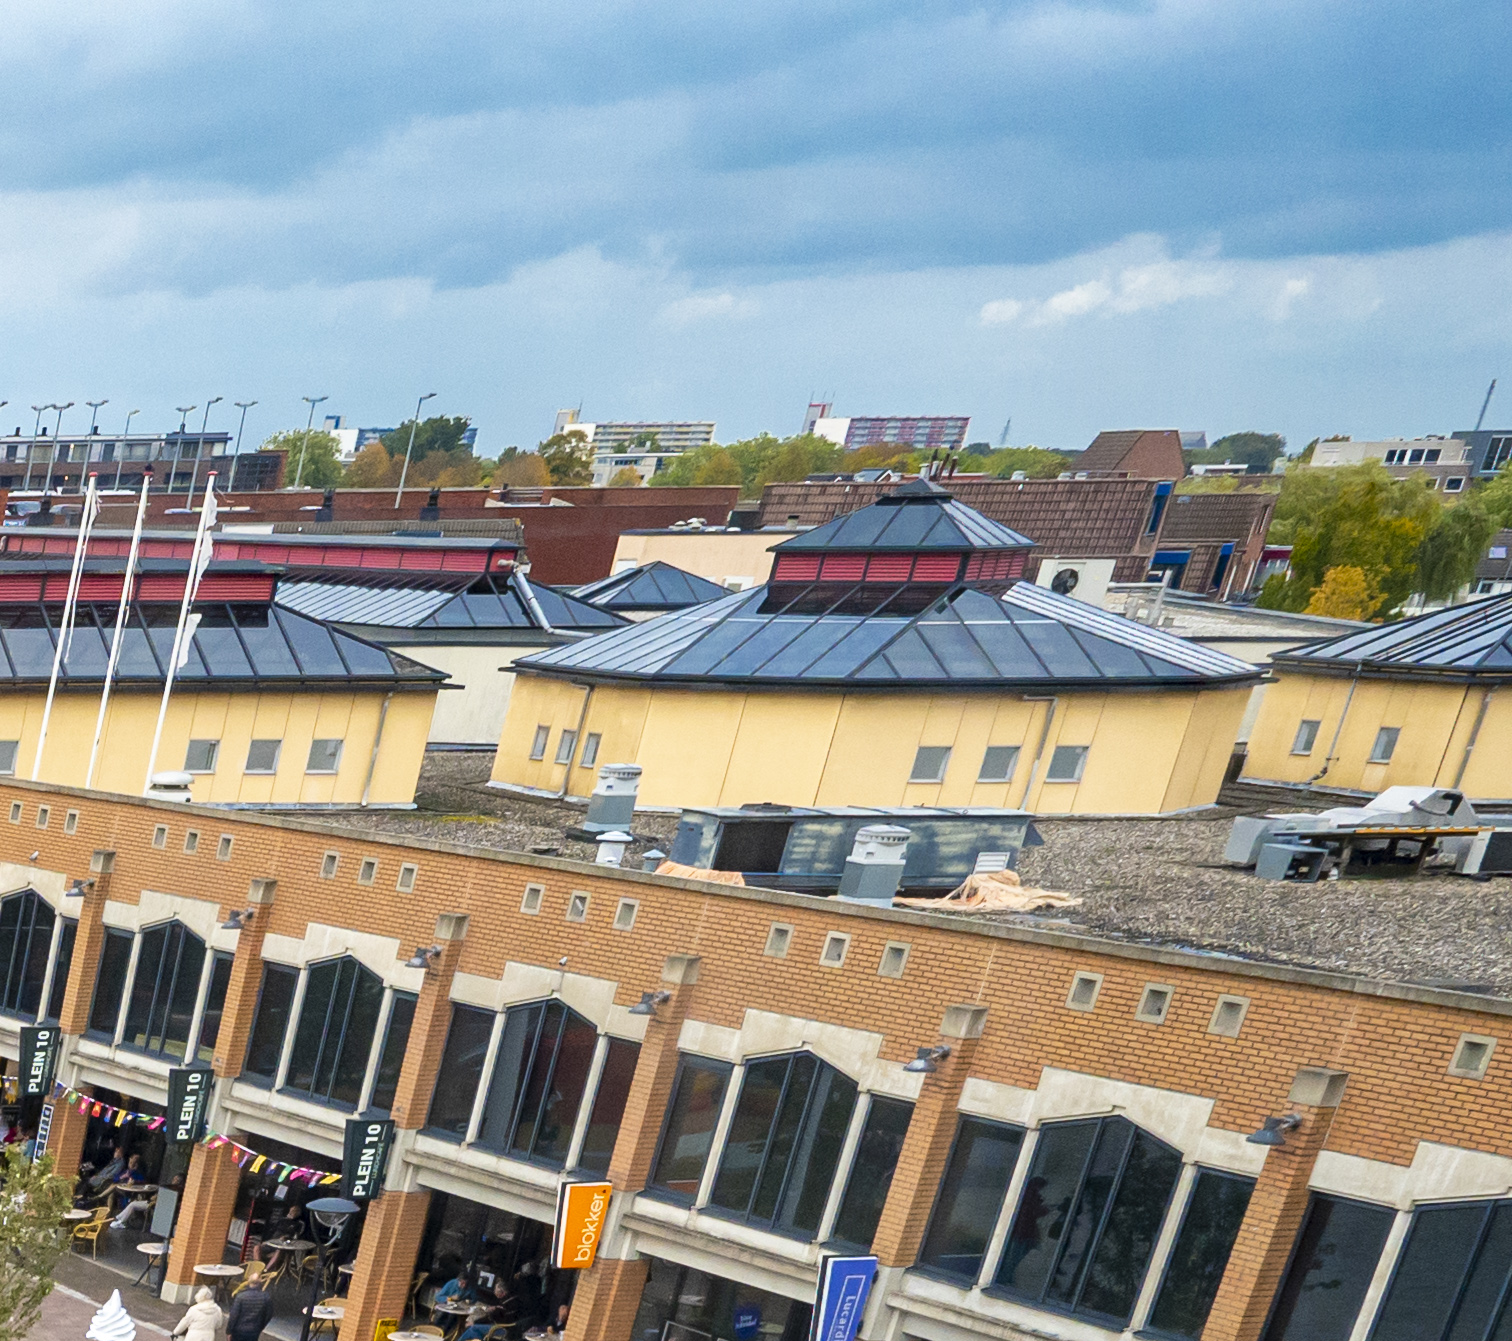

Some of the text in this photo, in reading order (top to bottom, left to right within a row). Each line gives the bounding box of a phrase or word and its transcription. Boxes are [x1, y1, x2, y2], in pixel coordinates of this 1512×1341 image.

[28, 1052, 46, 1093] PLEIN
[37, 1030, 50, 1048] 10
[176, 1073, 202, 1140] PLEIN 10
[352, 1124, 382, 1197] PLEIN 10
[573, 1192, 605, 1262] blokker
